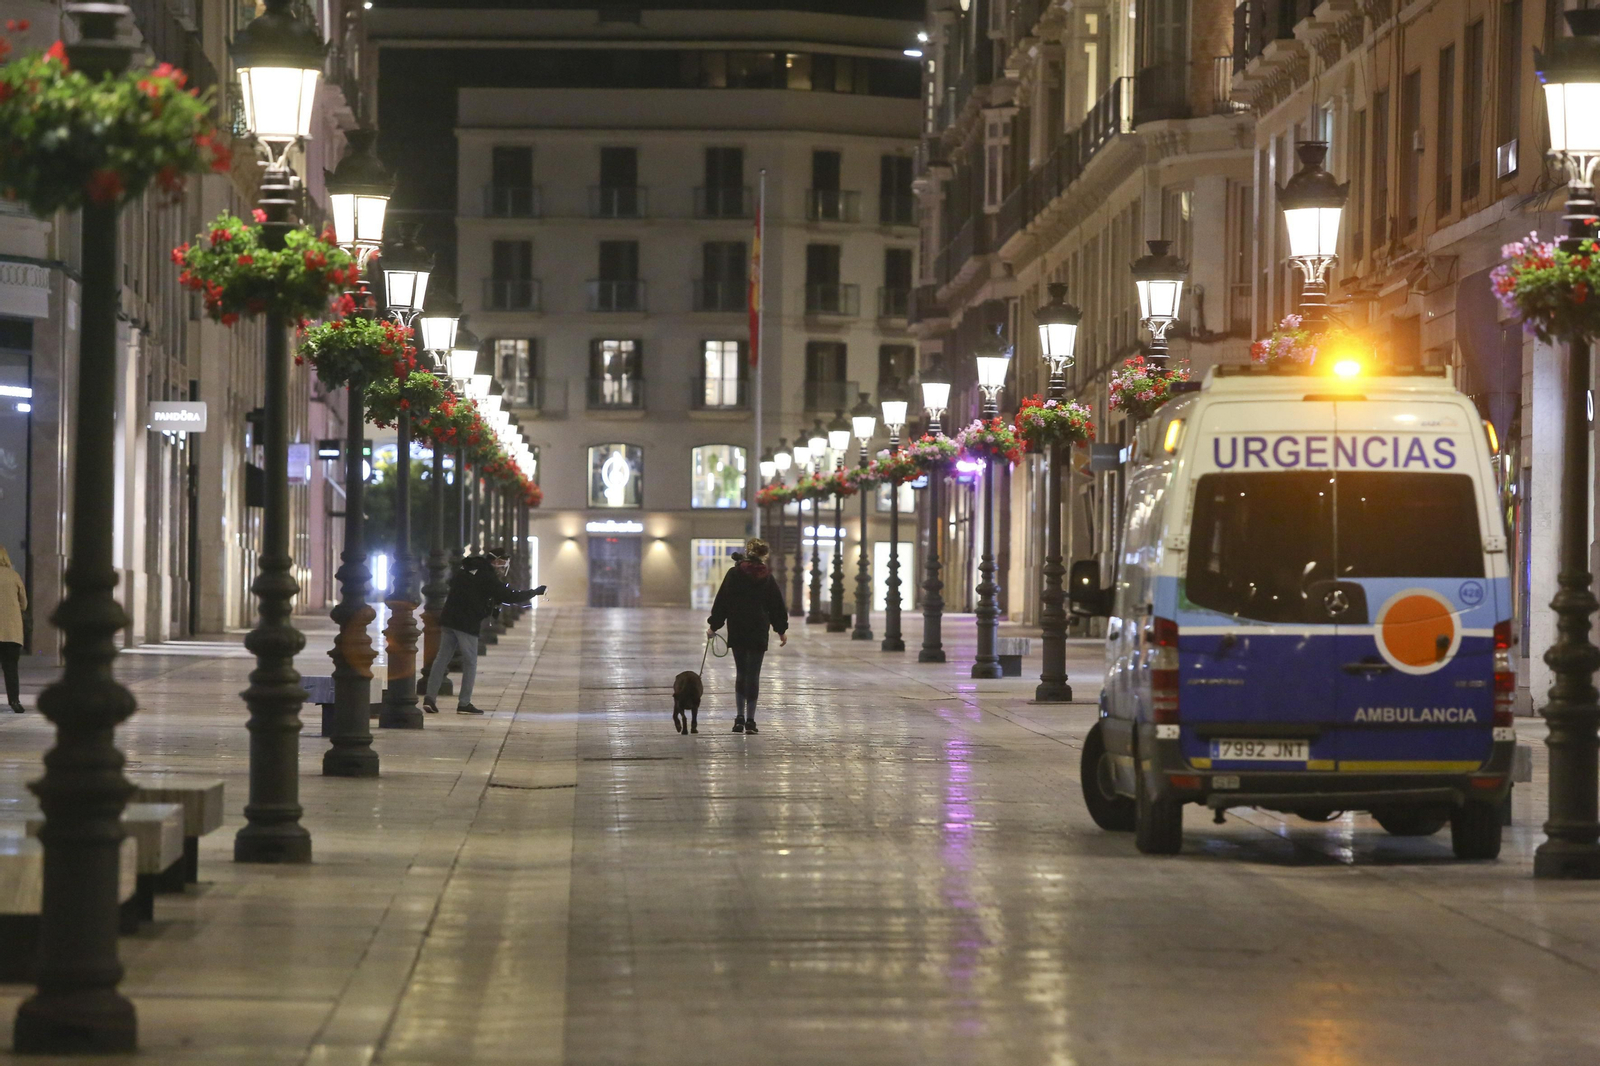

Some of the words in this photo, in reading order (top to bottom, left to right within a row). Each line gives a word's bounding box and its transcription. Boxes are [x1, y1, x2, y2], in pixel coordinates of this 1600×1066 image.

[154, 410, 201, 421] PANDORA
[1213, 435, 1457, 469] URGENCIAS
[1354, 707, 1477, 722] AMBULANCIA
[1221, 741, 1266, 757] 7992
[1273, 742, 1305, 758] JNT
